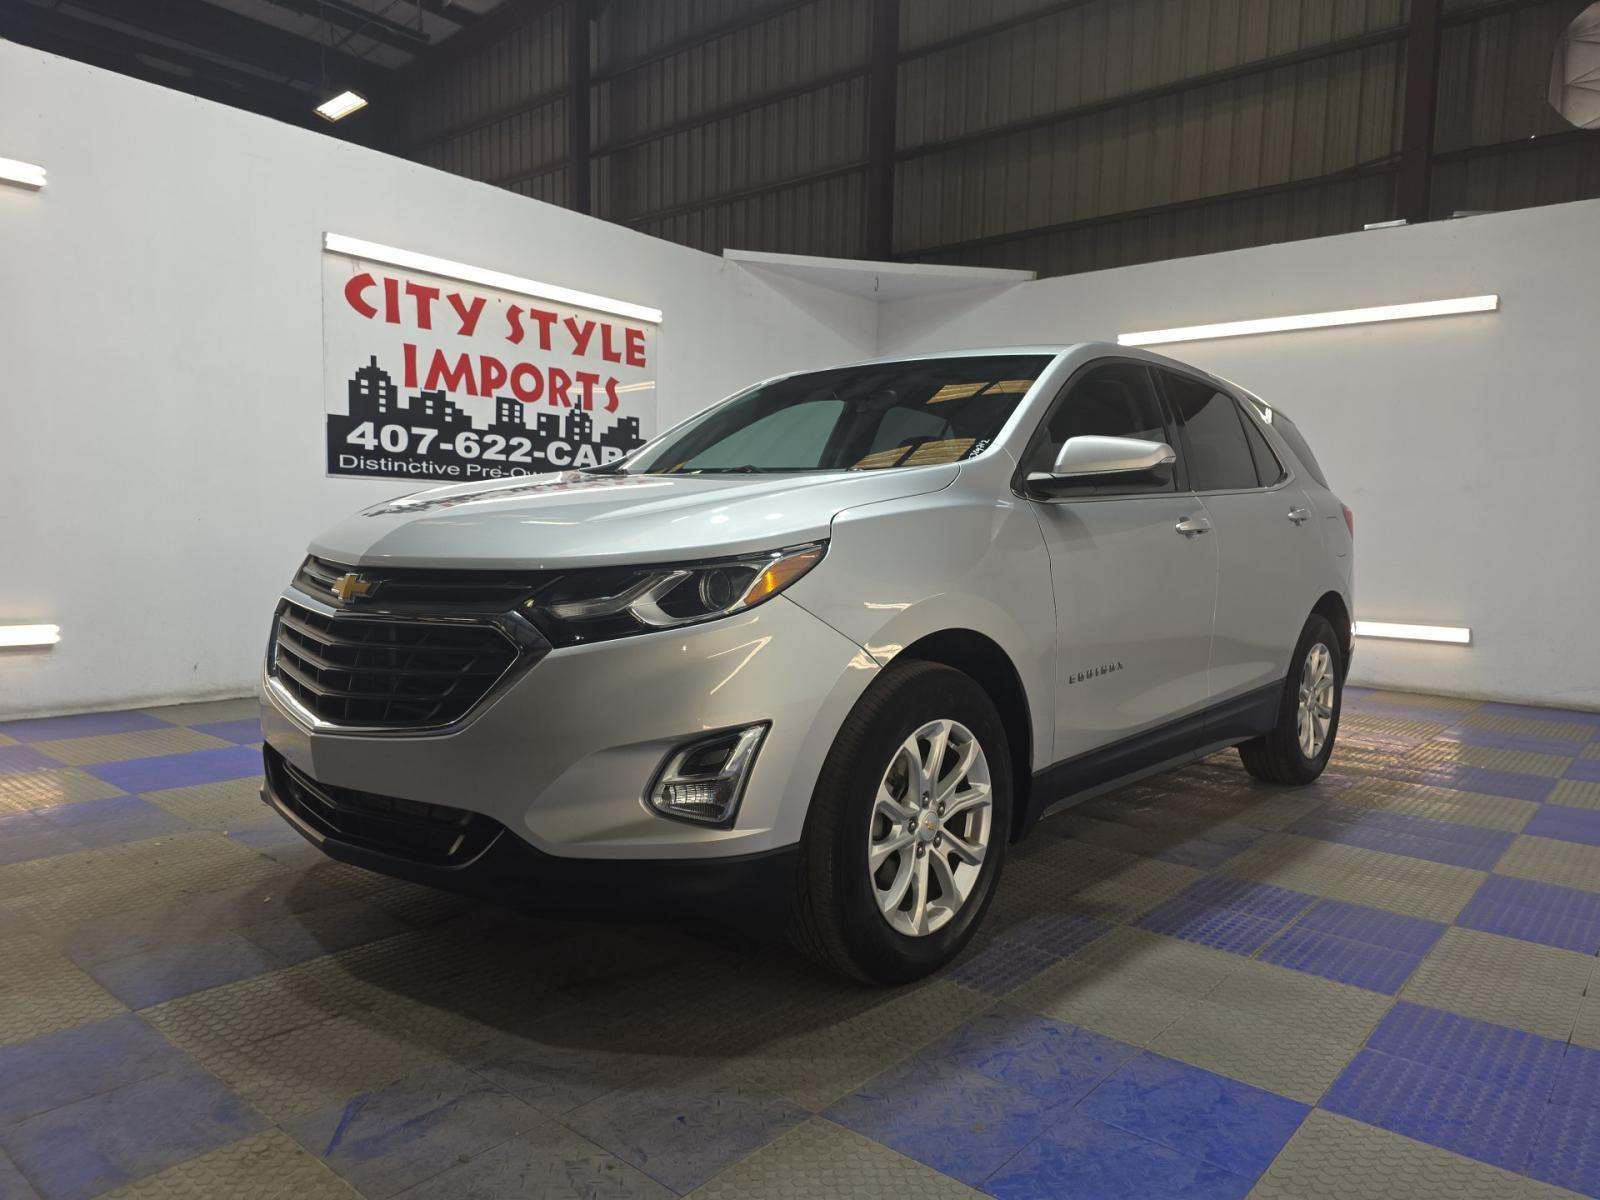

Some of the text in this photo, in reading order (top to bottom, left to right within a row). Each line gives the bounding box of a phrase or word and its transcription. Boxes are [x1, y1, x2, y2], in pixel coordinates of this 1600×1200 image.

[344, 272, 647, 368] CITY STYLE
[403, 343, 620, 413] IMPORTS
[339, 454, 545, 478] Distinctive Pre-O
